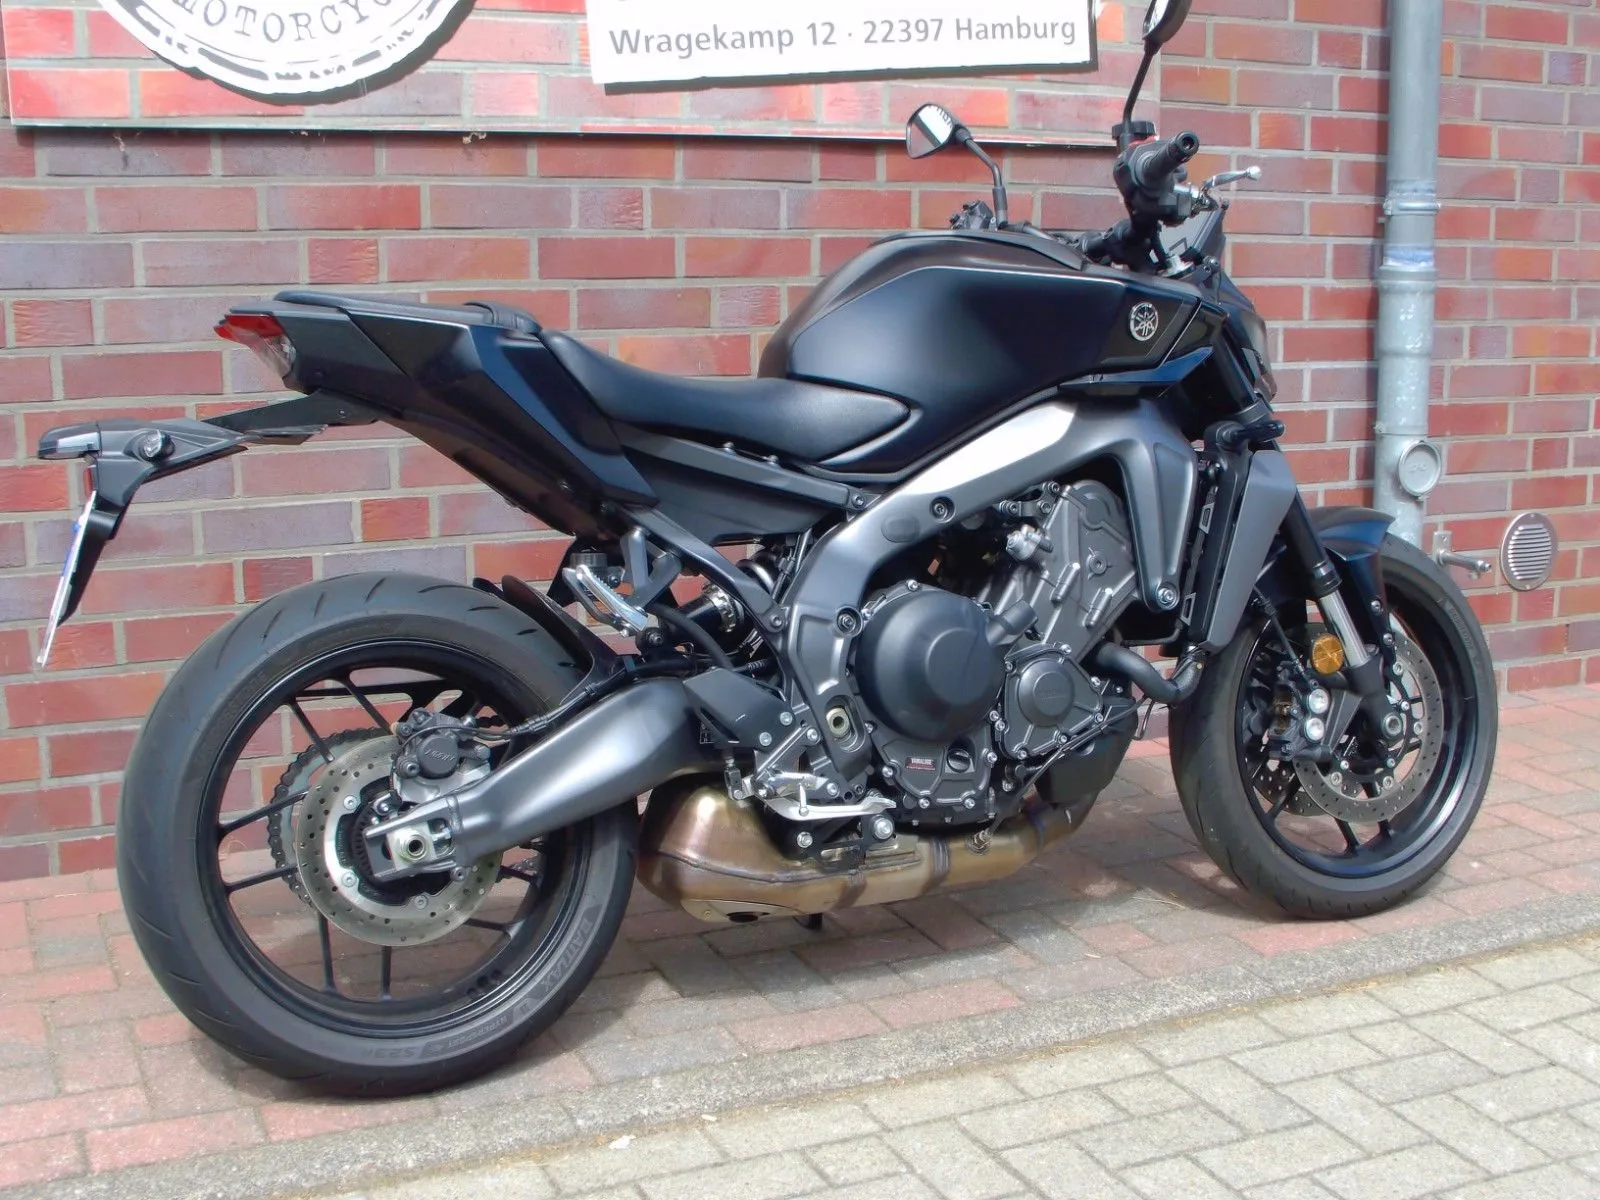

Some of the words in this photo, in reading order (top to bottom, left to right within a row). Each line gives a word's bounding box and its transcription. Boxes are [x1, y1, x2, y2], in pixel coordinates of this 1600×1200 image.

[171, 0, 393, 43] OTORCY
[608, 23, 794, 60] Wragekamp
[806, 21, 837, 47] 12
[863, 18, 944, 44] 22397
[955, 15, 1076, 46] Hamburg
